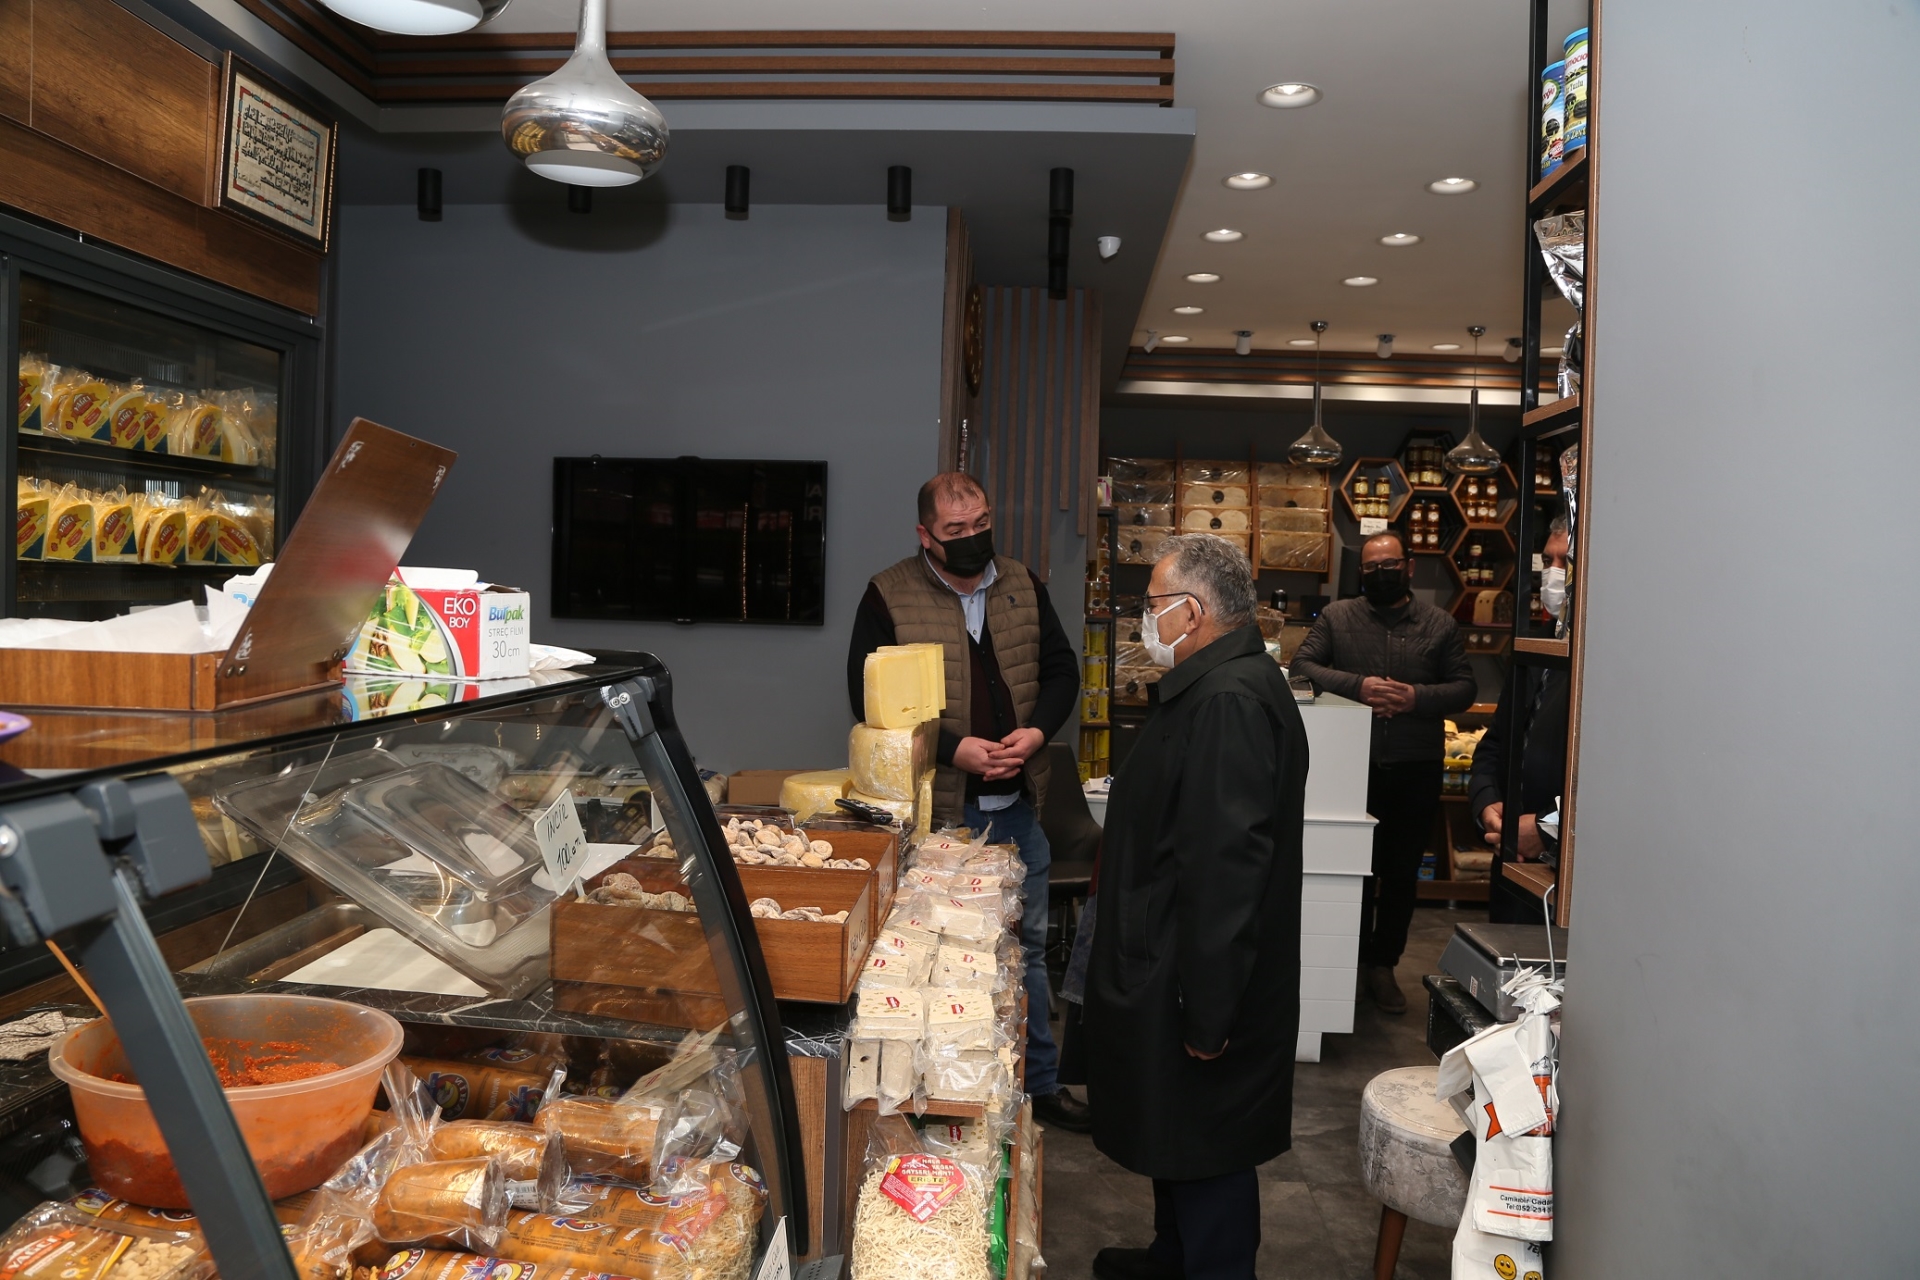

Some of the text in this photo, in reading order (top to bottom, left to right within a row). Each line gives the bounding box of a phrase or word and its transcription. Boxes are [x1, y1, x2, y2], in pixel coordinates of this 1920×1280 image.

[444, 597, 477, 616] EKO
[449, 617, 471, 629] BOY
[492, 640, 520, 658] 30 cm
